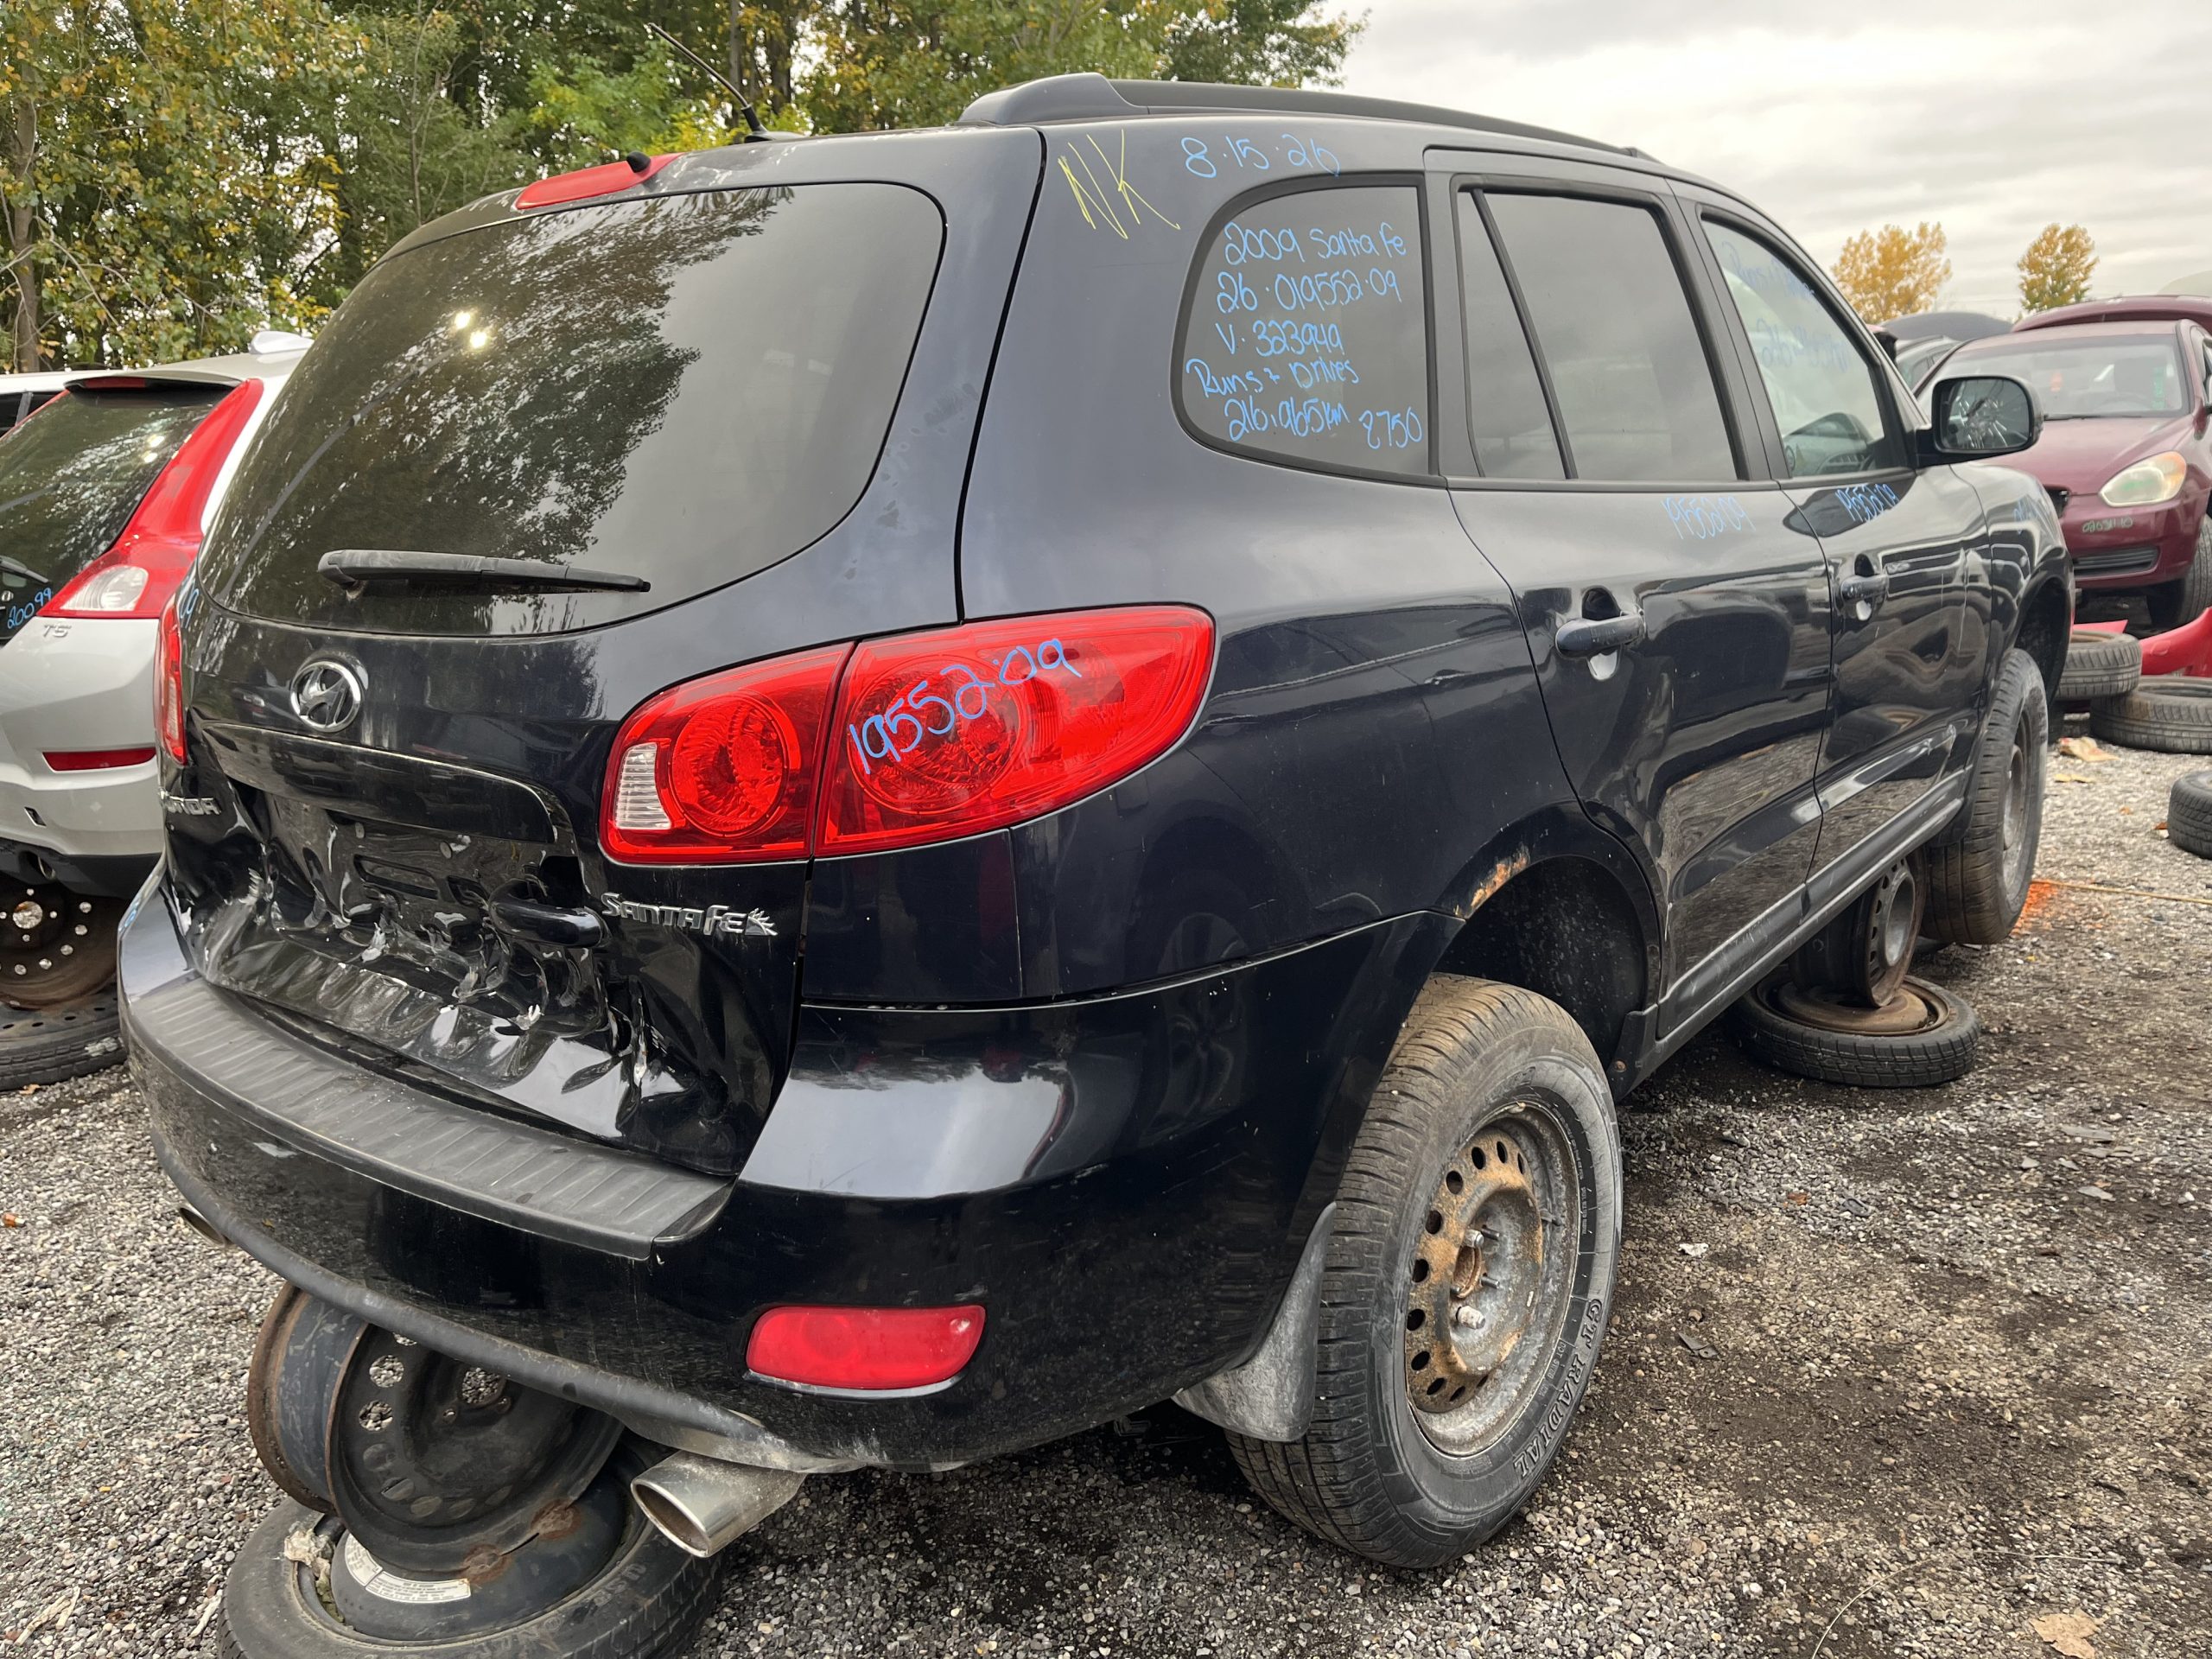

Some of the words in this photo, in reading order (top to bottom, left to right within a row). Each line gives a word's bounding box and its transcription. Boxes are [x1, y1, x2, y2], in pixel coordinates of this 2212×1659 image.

[1224, 221, 1306, 265] 2009
[1309, 227, 1380, 259] Santa
[1379, 221, 1408, 258] Fe
[1185, 357, 1263, 397] Runs
[1288, 355, 1360, 389] Drives
[43, 624, 73, 639] T5
[1580, 1298, 1603, 1350] GT
[1512, 1353, 1586, 1478] RADIAL
